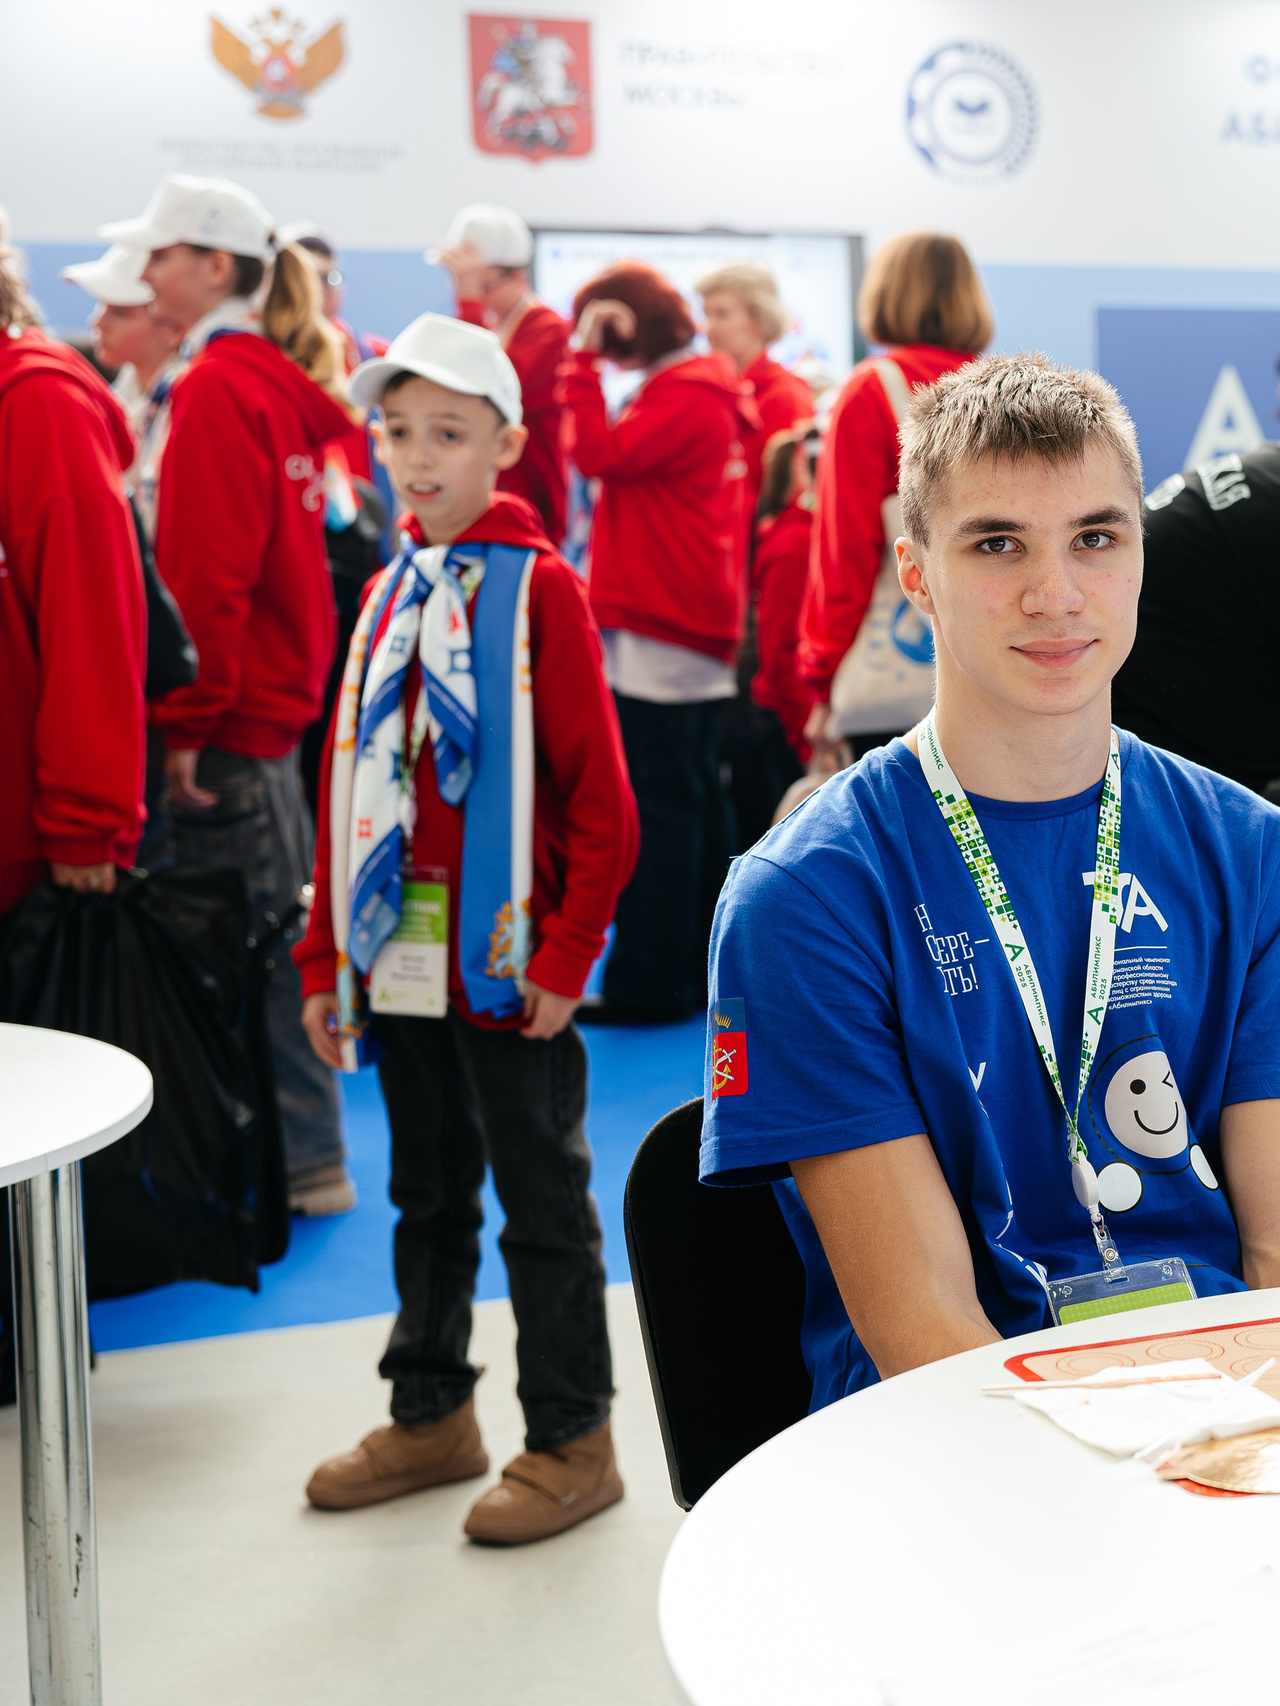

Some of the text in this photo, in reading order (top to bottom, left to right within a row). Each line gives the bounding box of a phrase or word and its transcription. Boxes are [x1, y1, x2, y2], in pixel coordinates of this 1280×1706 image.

[1090, 936, 1102, 998] АБИЛИМПИКС
[1113, 956, 1143, 965] ональный
[1015, 966, 1027, 988] 2025
[1110, 979, 1138, 988] астерству
[1113, 972, 1169, 982] профессиональному
[1023, 963, 1047, 1027] АБИЛИМПИКС
[1098, 978, 1107, 1000] 2025
